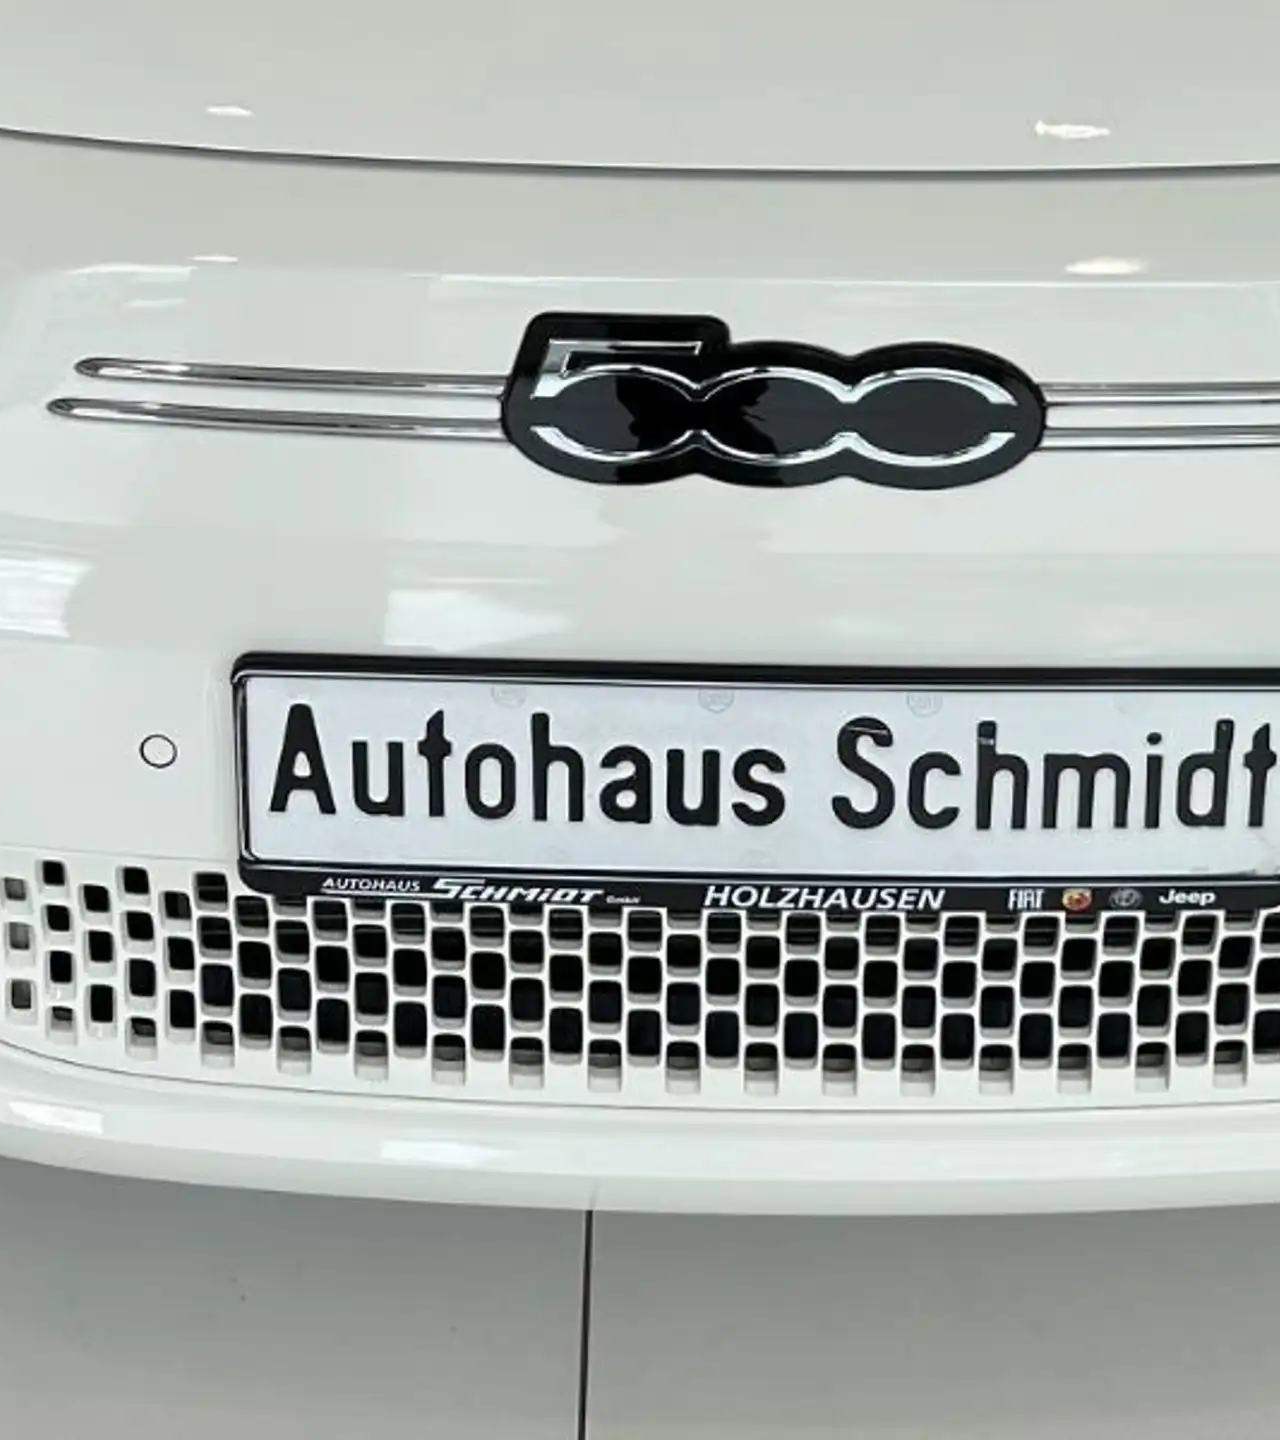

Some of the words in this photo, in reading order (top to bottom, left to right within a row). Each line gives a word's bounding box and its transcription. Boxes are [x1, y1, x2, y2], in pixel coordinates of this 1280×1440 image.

[528, 337, 1019, 469] 500
[268, 703, 787, 827] Autohaus
[831, 716, 1278, 831] Schmidt
[322, 876, 421, 893] AUTOHAUS
[702, 885, 946, 911] HOLZHAUSEN
[1007, 888, 1046, 911] FIAT
[1158, 888, 1217, 907] Jeep
